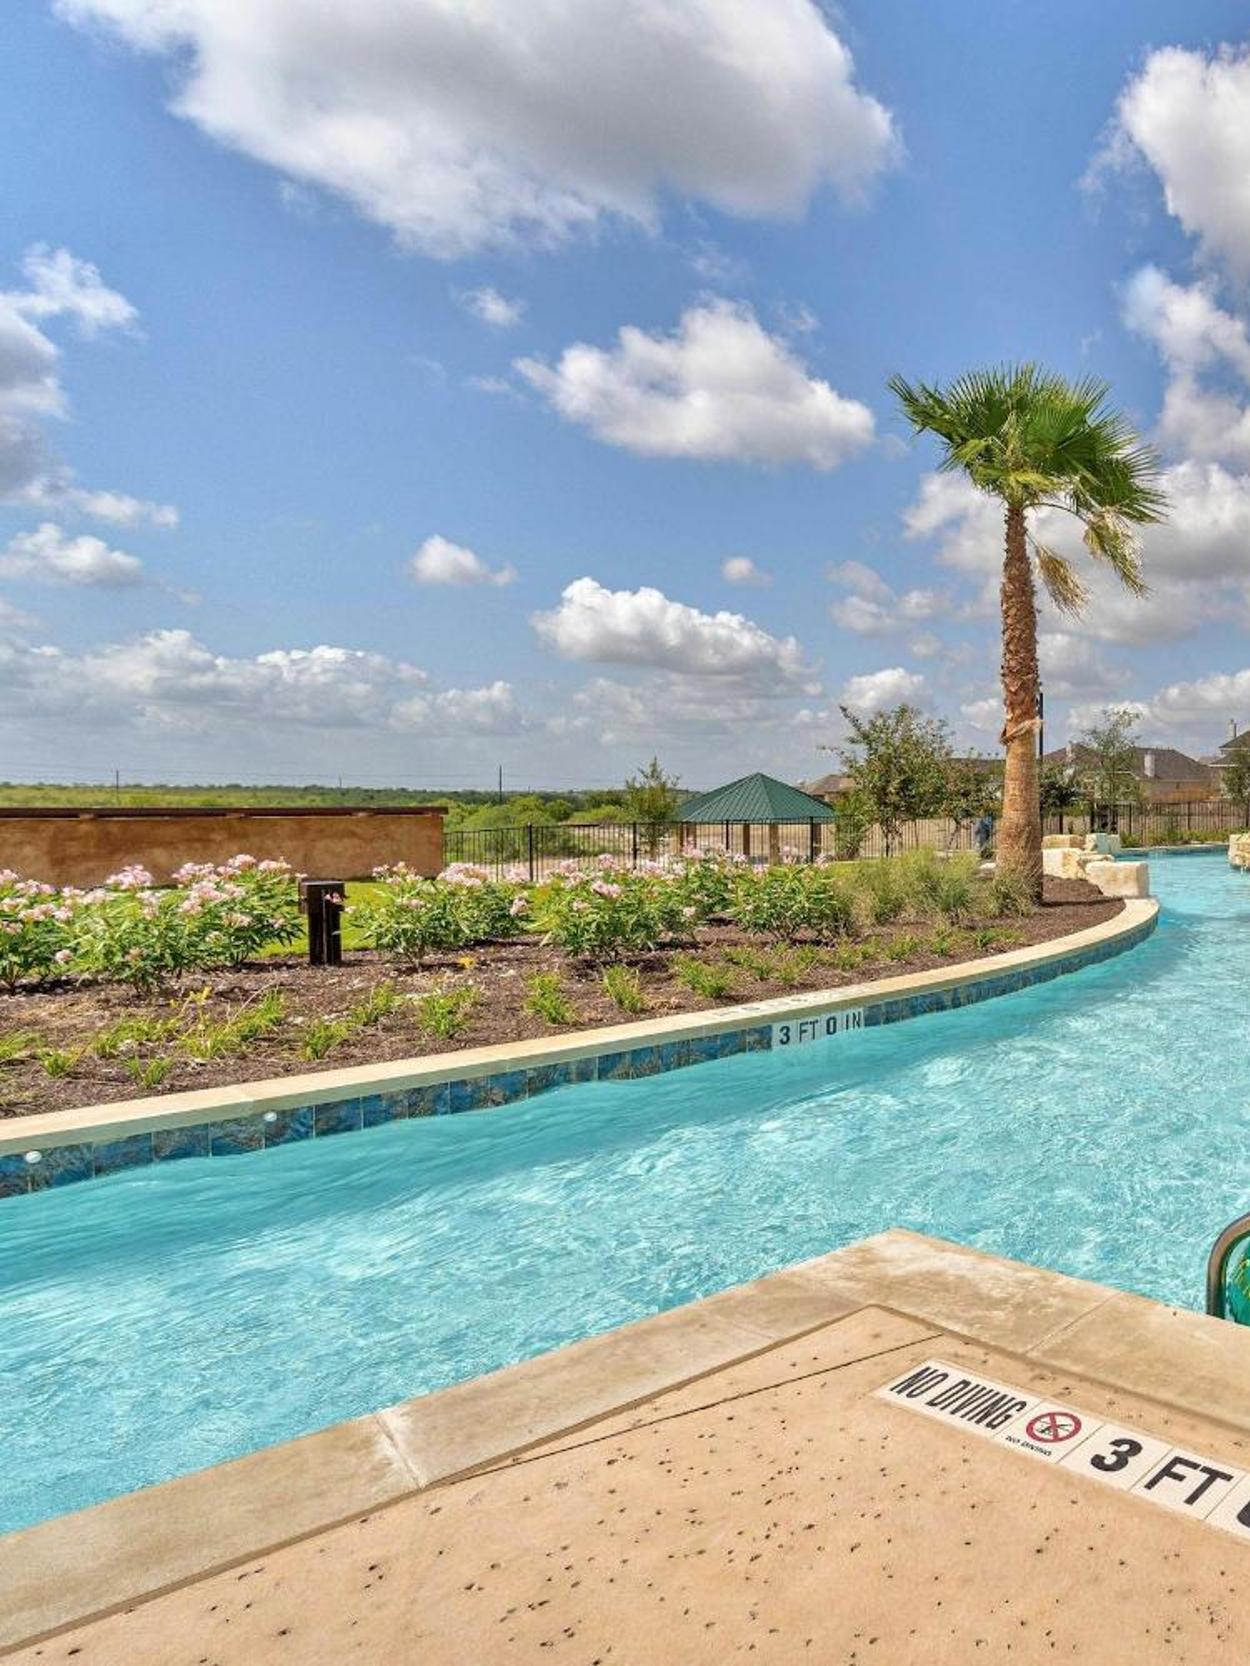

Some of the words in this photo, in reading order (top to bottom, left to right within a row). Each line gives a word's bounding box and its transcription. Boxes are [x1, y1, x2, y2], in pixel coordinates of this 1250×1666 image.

[779, 1025, 791, 1045] 3
[799, 1019, 819, 1043] FT
[845, 1011, 862, 1031] IN
[889, 1366, 949, 1398] NO
[926, 1379, 1027, 1430] DIVING
[1090, 1438, 1143, 1473] 3
[1144, 1456, 1234, 1506] FT
